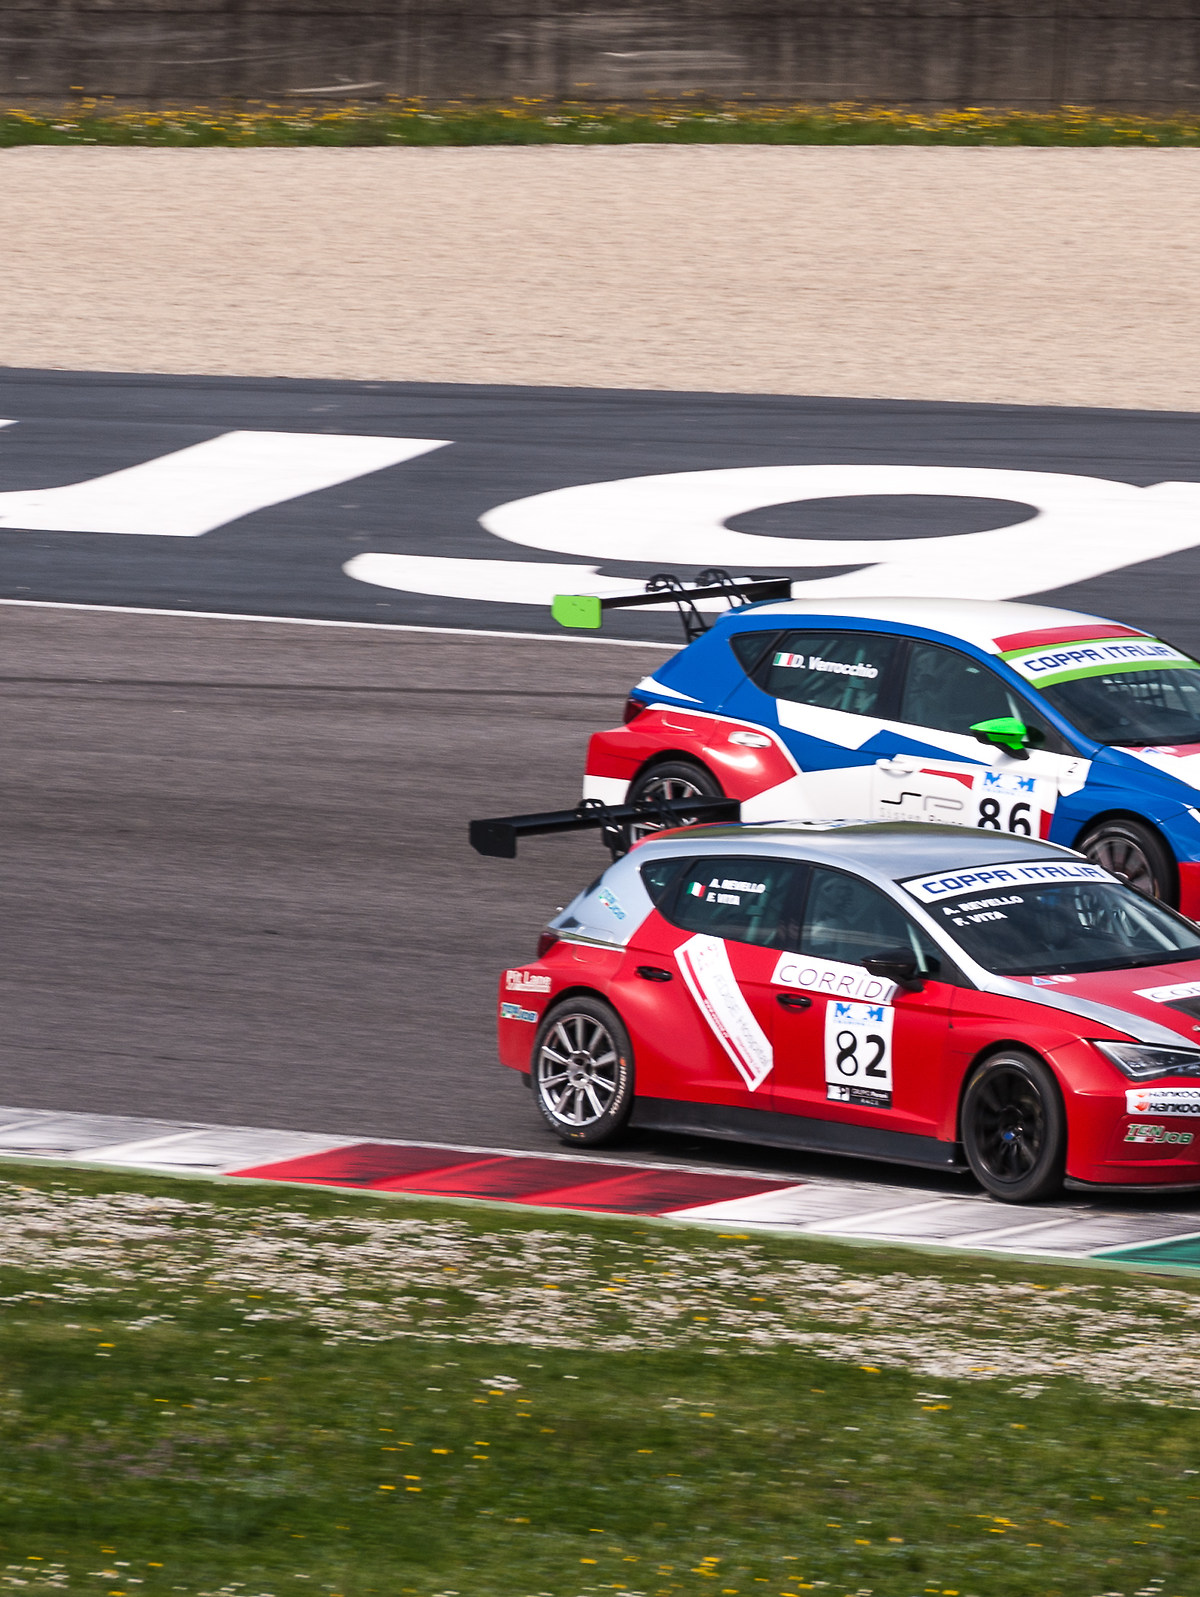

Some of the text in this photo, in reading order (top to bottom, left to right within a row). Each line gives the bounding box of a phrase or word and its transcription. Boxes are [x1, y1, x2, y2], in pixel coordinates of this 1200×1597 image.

[1023, 644, 1177, 672] COPPA ITALIA
[977, 797, 1031, 837] 86
[921, 865, 1106, 895] COPPA ITALIA
[957, 895, 1024, 912] REVELLO
[966, 910, 1008, 923] VITA
[779, 964, 894, 1002] CORRIDI
[836, 1029, 888, 1079] 82
